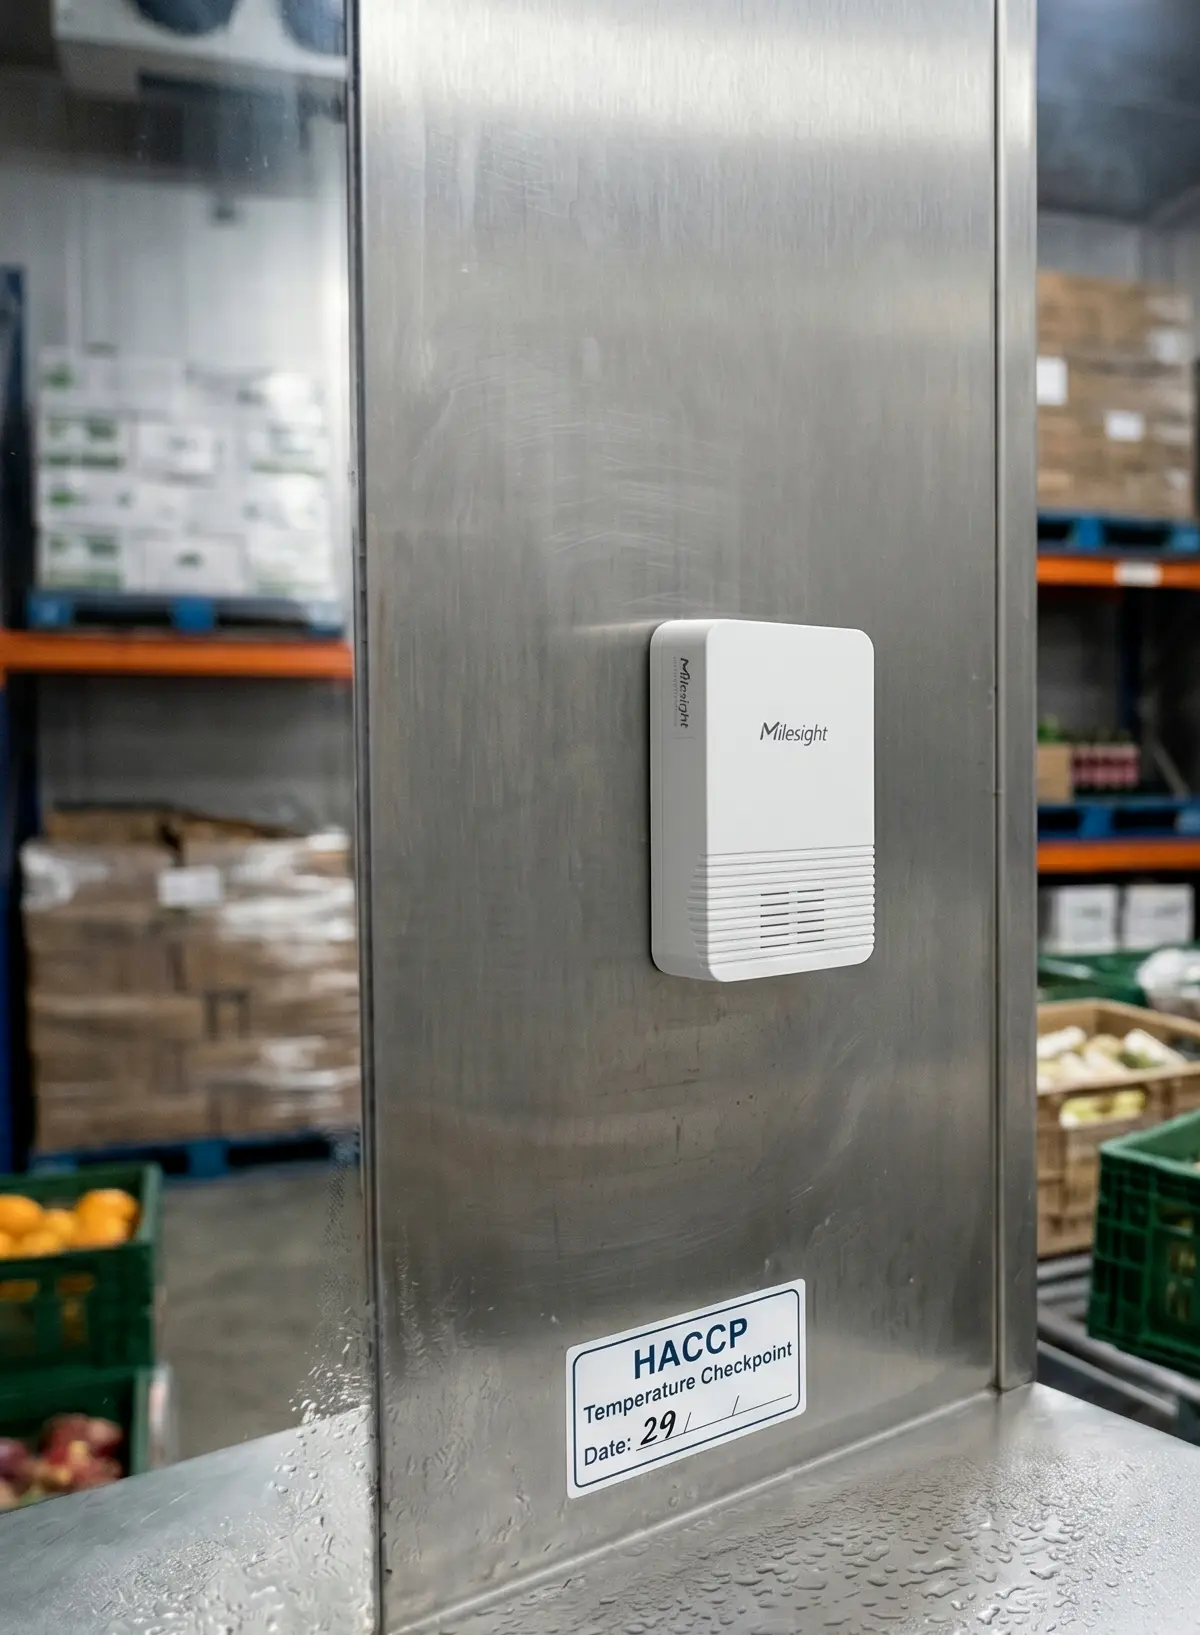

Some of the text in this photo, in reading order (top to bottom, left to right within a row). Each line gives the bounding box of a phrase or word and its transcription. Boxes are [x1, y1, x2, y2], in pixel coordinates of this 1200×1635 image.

[678, 657, 691, 729] Milesight
[759, 721, 829, 747] Milesight
[633, 1317, 748, 1380] HACCP
[583, 1341, 793, 1424] Temperature Checkpoint
[584, 1437, 632, 1466] Date:
[640, 1410, 677, 1446] 29
